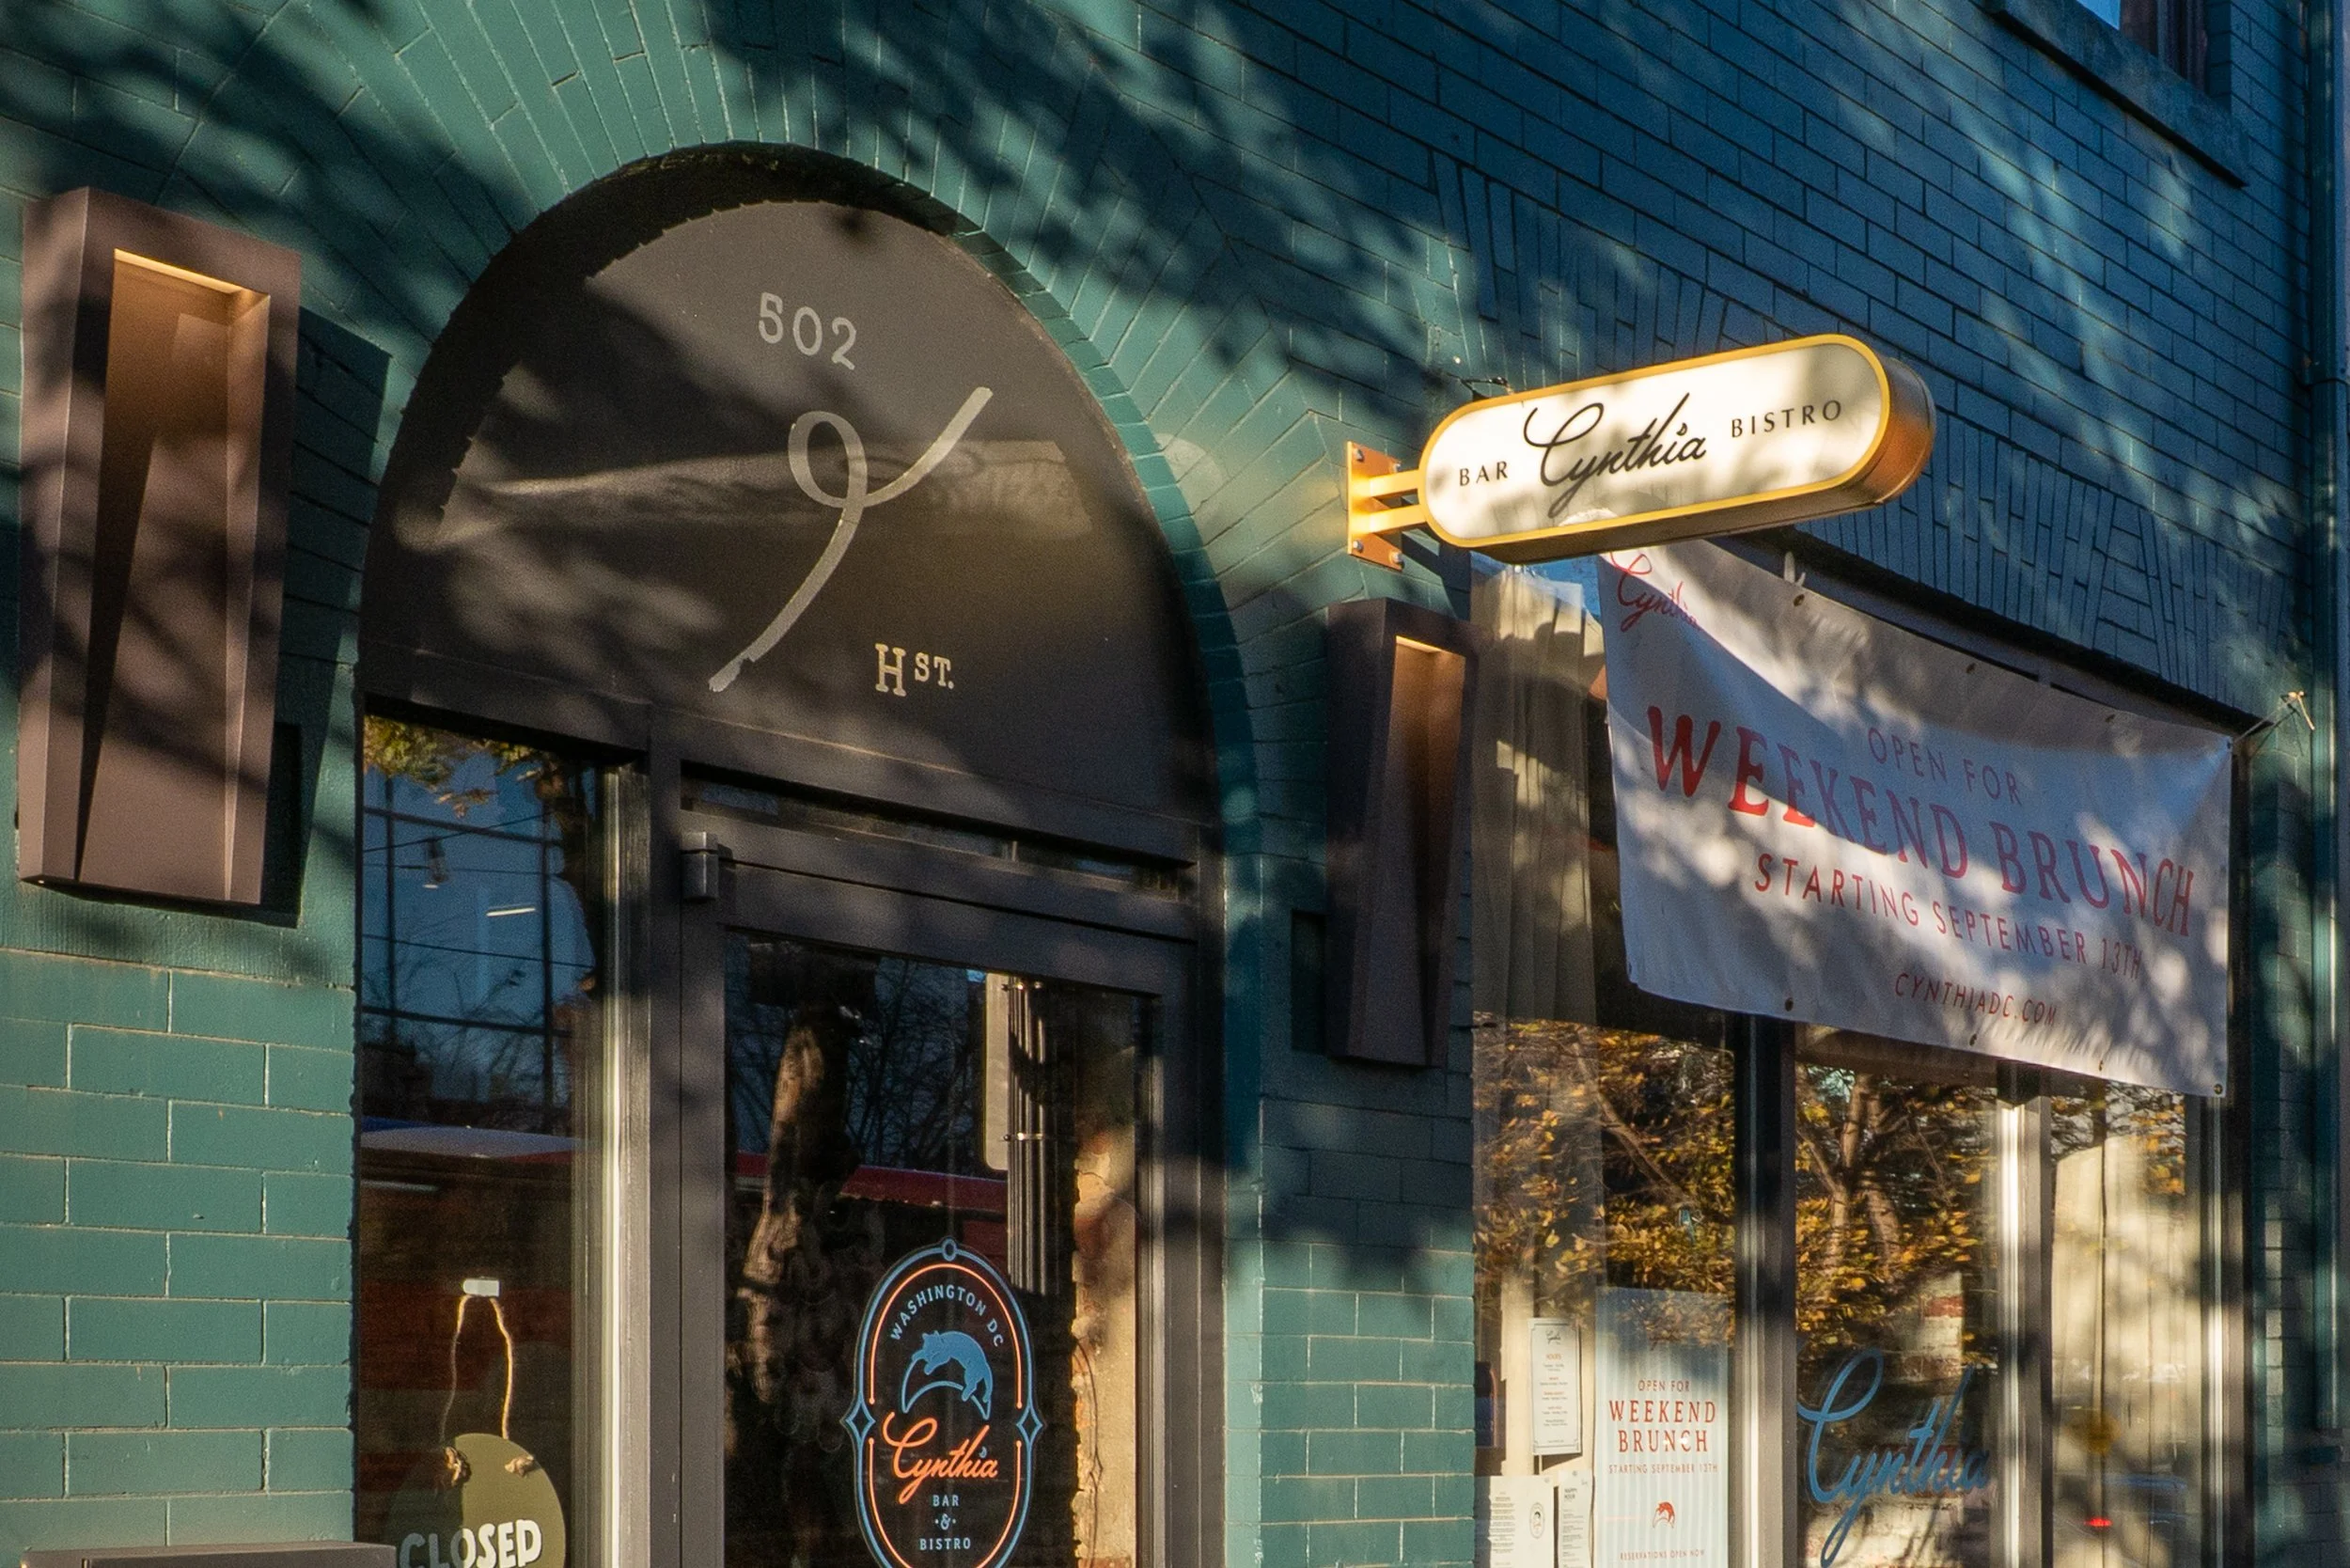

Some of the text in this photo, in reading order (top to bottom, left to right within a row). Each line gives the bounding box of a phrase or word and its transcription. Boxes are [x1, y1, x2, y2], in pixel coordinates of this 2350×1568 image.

[758, 291, 857, 371] 502
[1458, 391, 1842, 518] BAR Cynthia BISTRO
[874, 642, 955, 698] H ST.
[1867, 727, 2022, 807] OPEN FOR
[1647, 705, 2195, 937] WEEKEND BRUNCH
[1754, 852, 2143, 980] STARTING SEPTEMBER 13TH
[1894, 972, 2058, 1026] CYNTHIADC.COM
[889, 1283, 1005, 1348] WASHINGTON DC
[1608, 1400, 1716, 1423] WEEKEND
[1637, 1379, 1690, 1392] OPEN FOR
[882, 1411, 999, 1505] Cynthia
[1618, 1429, 1708, 1453] BRUNCH
[1797, 1346, 1991, 1568] Cynthia
[1608, 1464, 1648, 1475] STARTING
[1651, 1463, 1695, 1474] SEPTEMBER
[932, 1494, 960, 1507] BAR
[400, 1519, 542, 1568] CLOSED
[919, 1536, 971, 1551] BISTRO
[1669, 1549, 1687, 1560] OPEN
